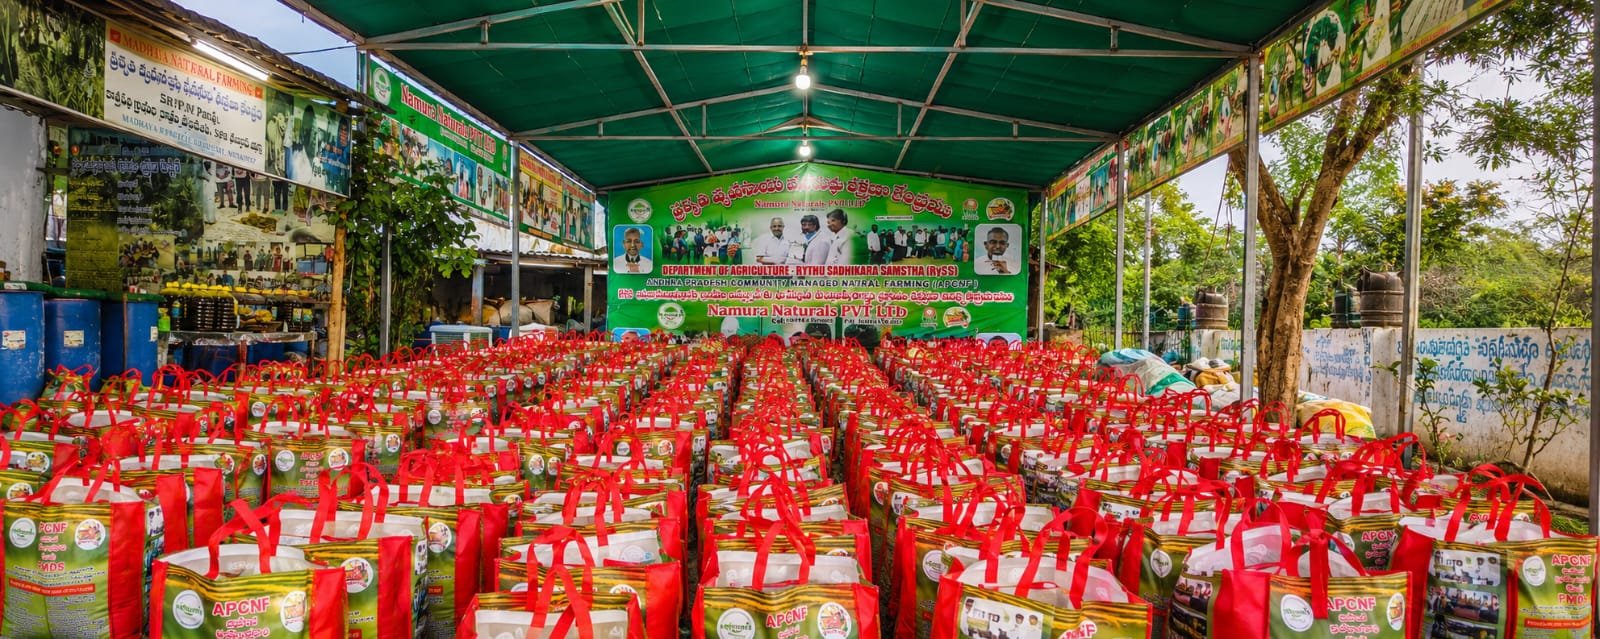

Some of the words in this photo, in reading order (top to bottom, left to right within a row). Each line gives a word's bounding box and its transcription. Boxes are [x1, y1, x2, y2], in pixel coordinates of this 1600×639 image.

[661, 265, 717, 277] DEPARTMENT
[718, 265, 729, 277] OF
[731, 265, 789, 277] AGRICULTURE
[796, 265, 826, 277] RYTHU
[827, 265, 879, 277] SADHIKARA
[880, 265, 925, 277] SAMSTHA
[926, 265, 958, 278] (RySS)
[646, 279, 682, 288] ANDHRA
[685, 279, 728, 288] PRADESH
[884, 280, 930, 289] FARMING
[708, 304, 768, 317] Namura
[771, 304, 837, 317] Naturals
[841, 305, 872, 317] PVT
[212, 595, 270, 617] APCNF
[1558, 593, 1586, 606] PMD
[766, 604, 808, 629] APCNF
